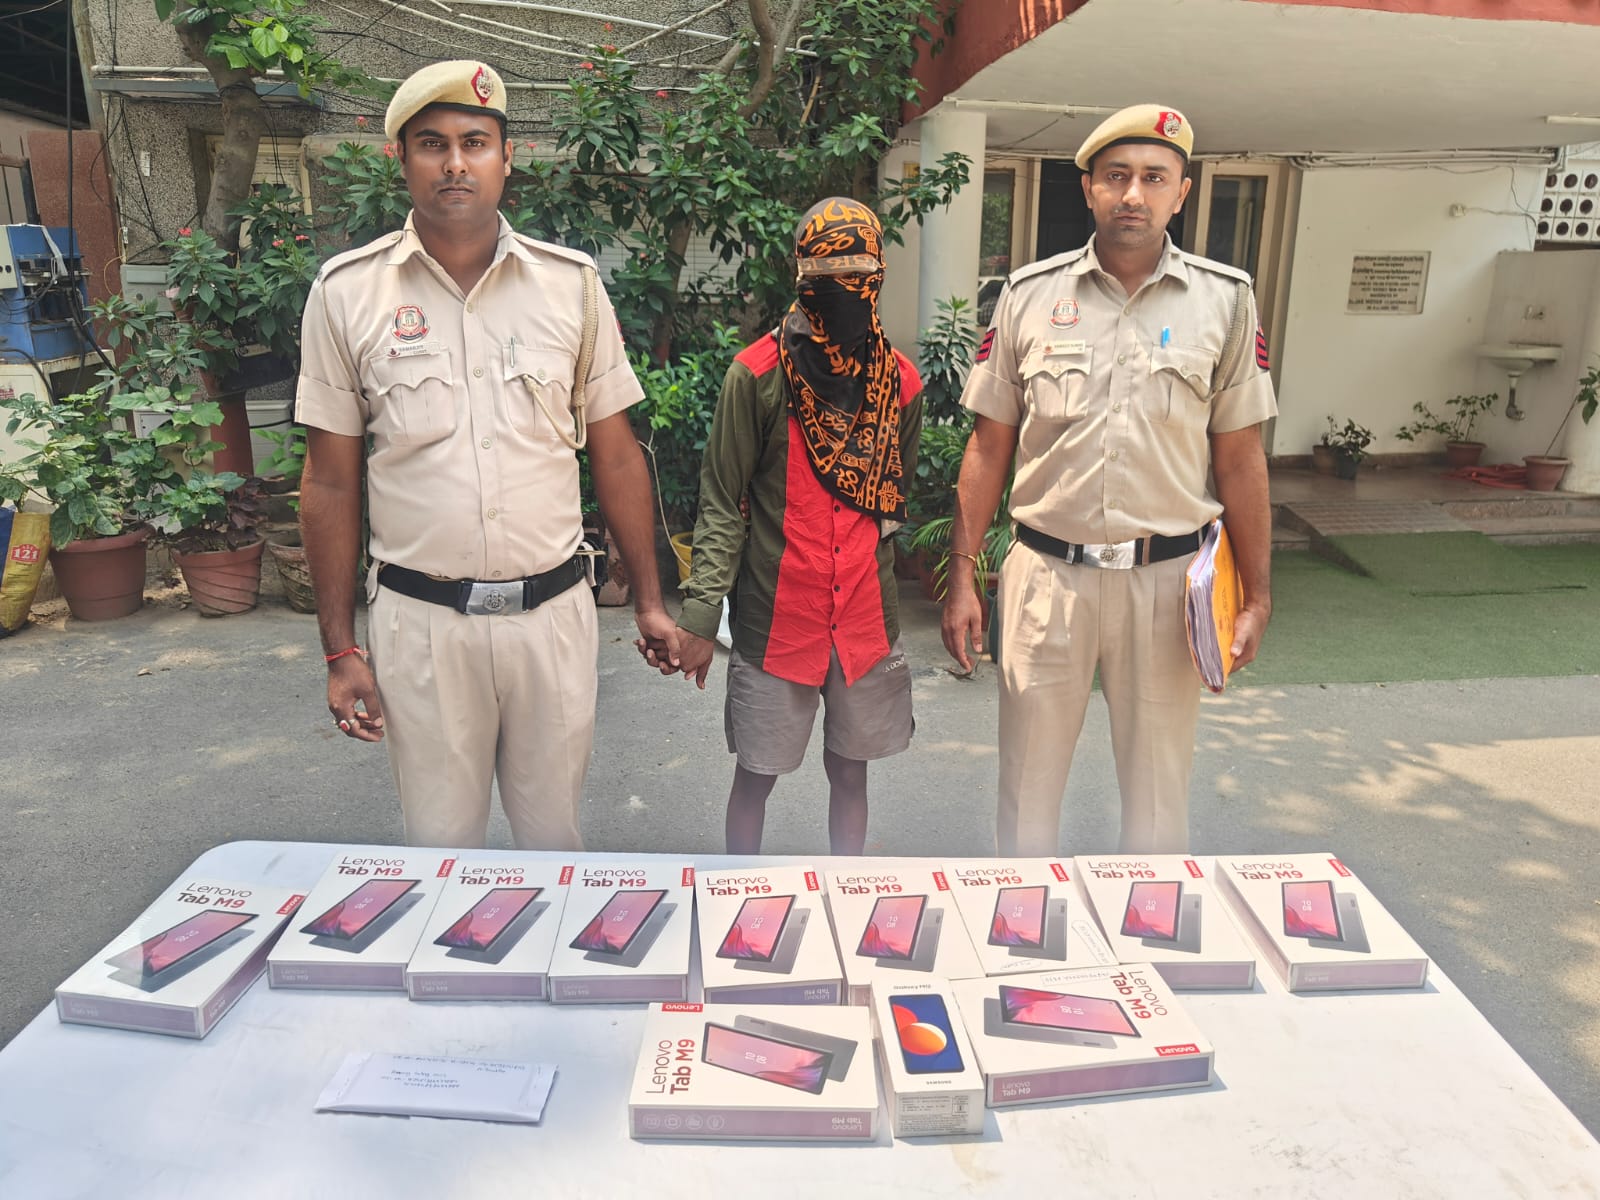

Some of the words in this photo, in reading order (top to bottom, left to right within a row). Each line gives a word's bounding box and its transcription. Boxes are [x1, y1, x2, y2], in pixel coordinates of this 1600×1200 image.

[13, 549, 38, 560] 121
[341, 856, 405, 867] Lenovo
[1088, 861, 1150, 869] Lenovo
[1232, 862, 1294, 870] Lenovo
[338, 866, 369, 876] Tab
[373, 867, 403, 876] M9
[461, 866, 525, 876] Lenovo
[584, 868, 646, 878] Lenovo
[955, 868, 1016, 877] Lenovo
[1091, 870, 1124, 879] Tab
[1129, 870, 1156, 879] M9
[1237, 871, 1271, 880] Tab
[1276, 870, 1303, 879] M9
[458, 876, 490, 885] Tab
[495, 876, 524, 885] M9
[582, 878, 614, 887] Tab
[619, 878, 647, 887] M9
[707, 876, 768, 886] Lenovo
[837, 875, 897, 885] Lenovo
[958, 877, 991, 887] Tab
[995, 876, 1023, 885] M9
[186, 882, 253, 898] Lenovo
[707, 886, 739, 896] Tab
[745, 885, 772, 894] M9
[838, 885, 870, 895] Tab
[876, 884, 903, 893] M9
[177, 893, 210, 905] Tab
[213, 897, 246, 909] M9
[1110, 972, 1133, 996] Tab
[1125, 998, 1152, 1020] M9
[1128, 970, 1168, 1016] Lenovo
[665, 1003, 702, 1011] Lenovo
[676, 1039, 696, 1063] M9
[1159, 1045, 1197, 1055] Lenovo
[645, 1040, 673, 1094] Lenovo
[670, 1065, 693, 1095] Tab
[1002, 1089, 1018, 1097] Tab
[846, 1117, 863, 1125] Tab
